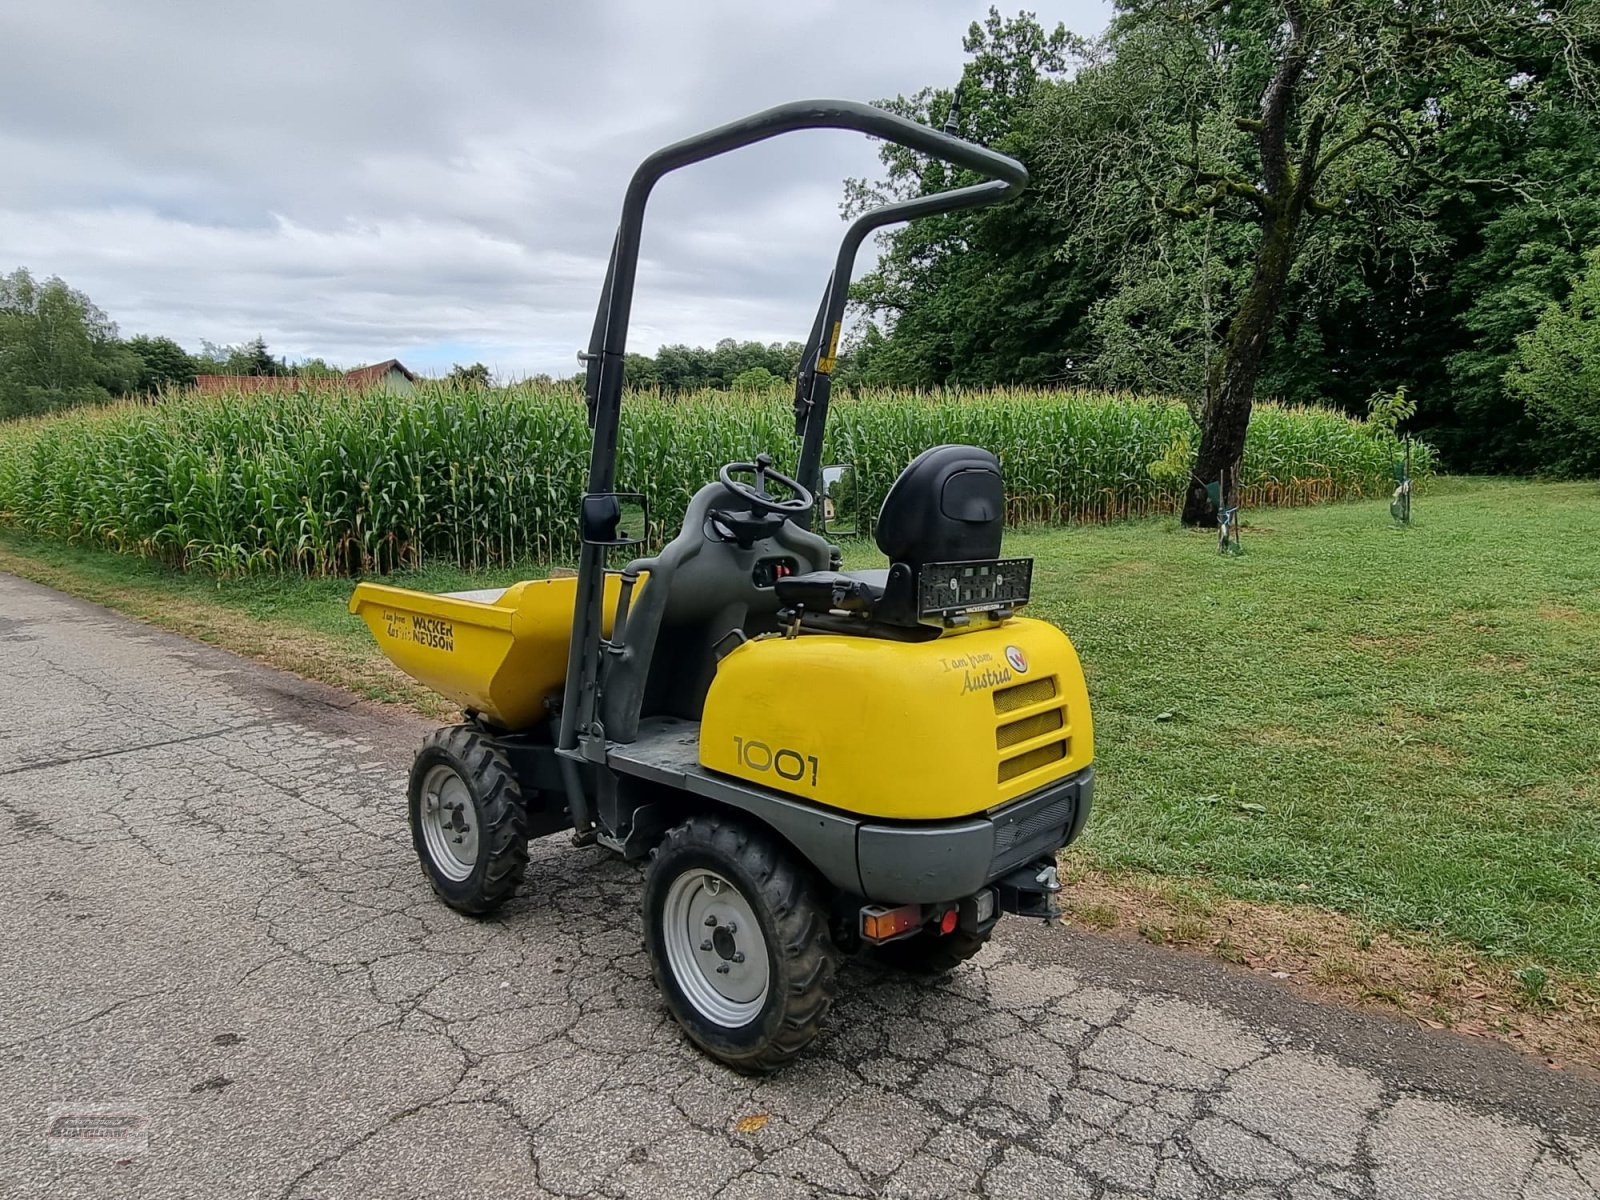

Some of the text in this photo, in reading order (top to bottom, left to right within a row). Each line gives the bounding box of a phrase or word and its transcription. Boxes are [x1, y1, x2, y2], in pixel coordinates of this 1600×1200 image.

[412, 615, 454, 637] WACKER
[412, 630, 454, 652] NEUSON
[941, 653, 993, 673] I am from
[960, 664, 1012, 696] Austria
[733, 735, 818, 787] 1001
